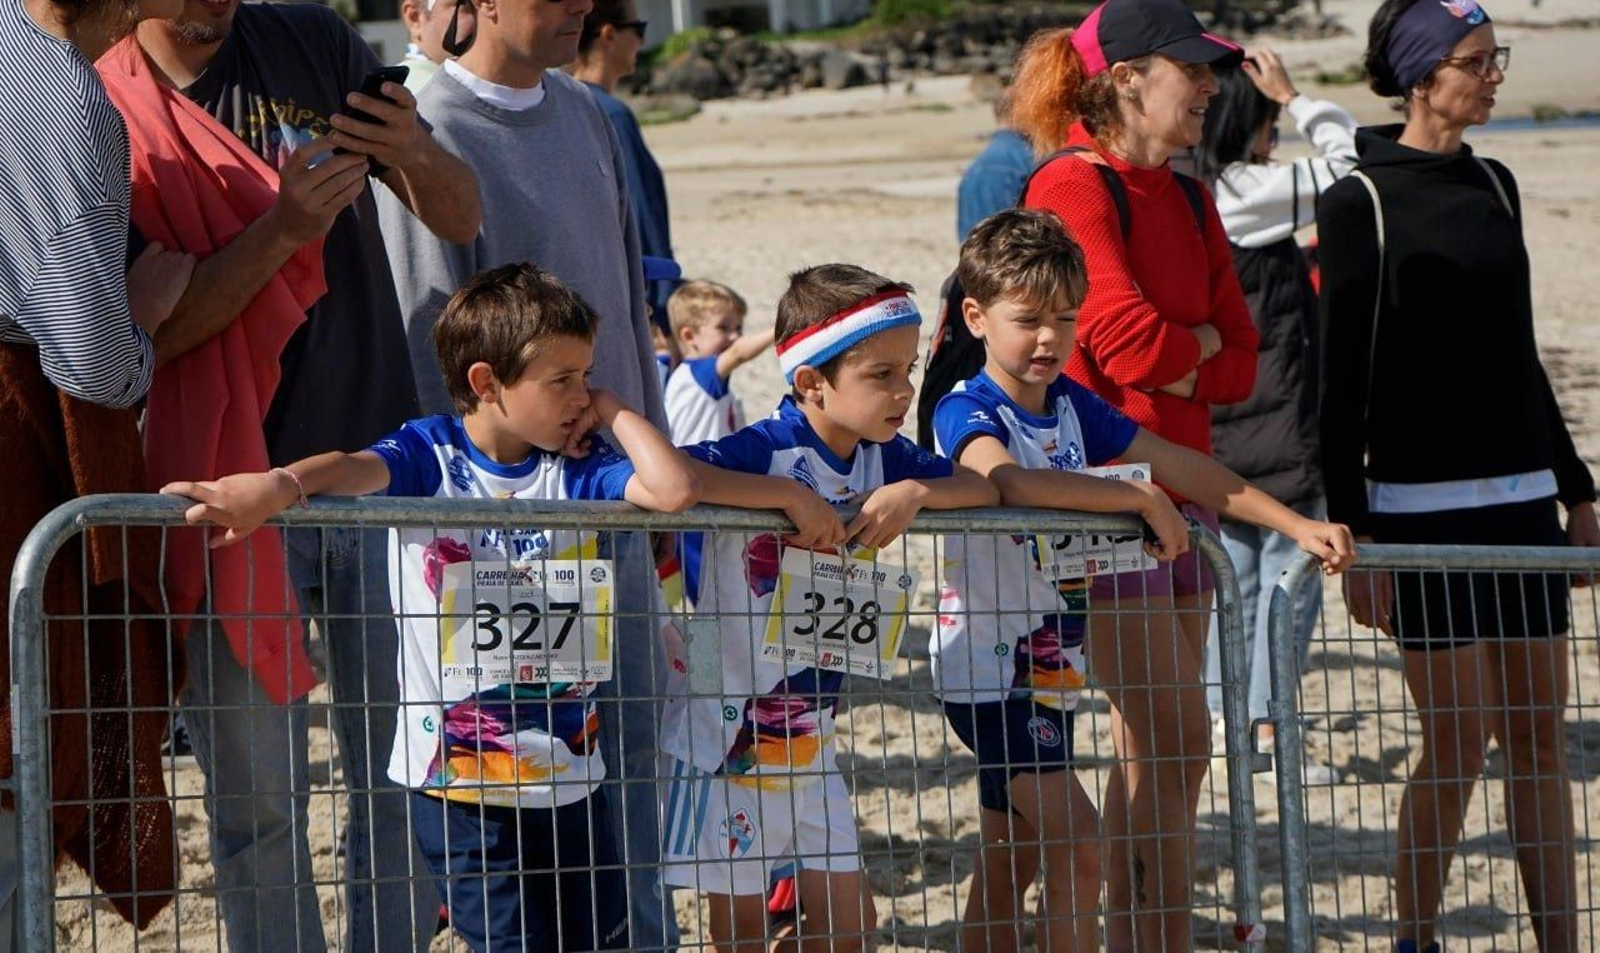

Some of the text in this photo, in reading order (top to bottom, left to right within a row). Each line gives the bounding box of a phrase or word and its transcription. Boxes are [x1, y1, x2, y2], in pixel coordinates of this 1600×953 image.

[555, 570, 575, 580] 100
[471, 602, 582, 651] 327
[793, 592, 882, 645] 328
[465, 667, 483, 676] 100
